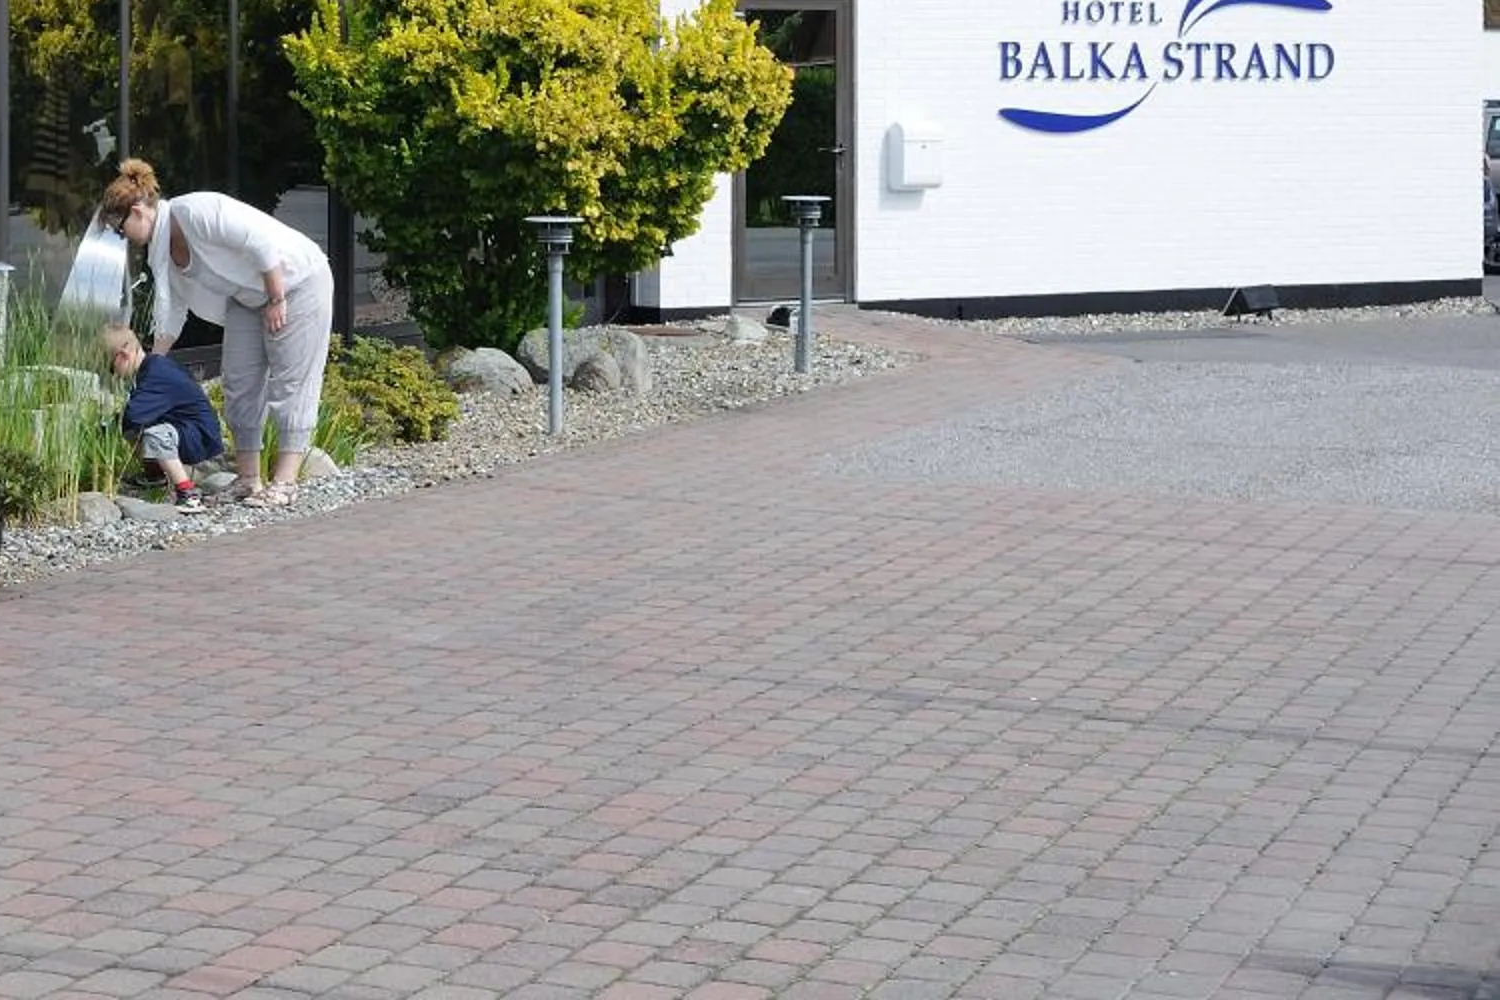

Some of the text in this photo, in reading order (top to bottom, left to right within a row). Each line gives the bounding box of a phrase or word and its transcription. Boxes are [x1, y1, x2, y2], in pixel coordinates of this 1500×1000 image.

[1061, 0, 1163, 25] HOTEL
[998, 41, 1335, 81] BALKA STRAND
